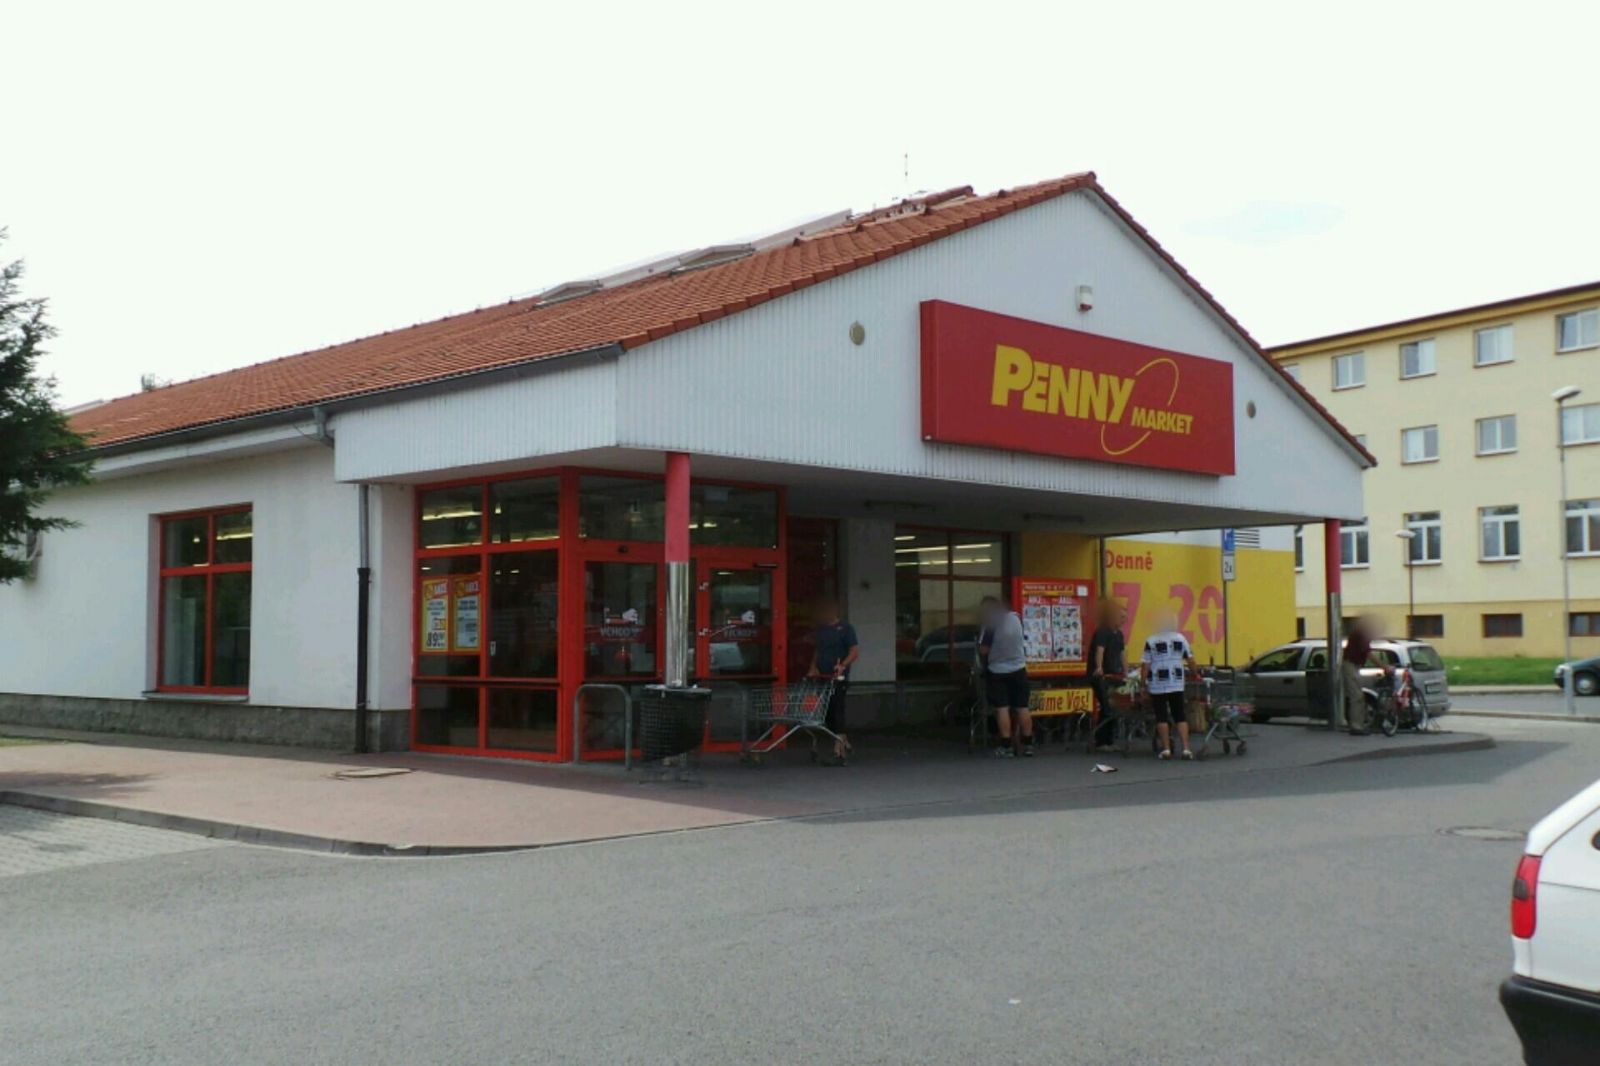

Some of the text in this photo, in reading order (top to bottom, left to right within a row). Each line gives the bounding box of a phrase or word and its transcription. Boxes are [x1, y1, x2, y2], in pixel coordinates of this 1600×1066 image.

[991, 343, 1136, 424] PENNY
[1131, 406, 1194, 435] MARKET
[1168, 584, 1225, 646] 20
